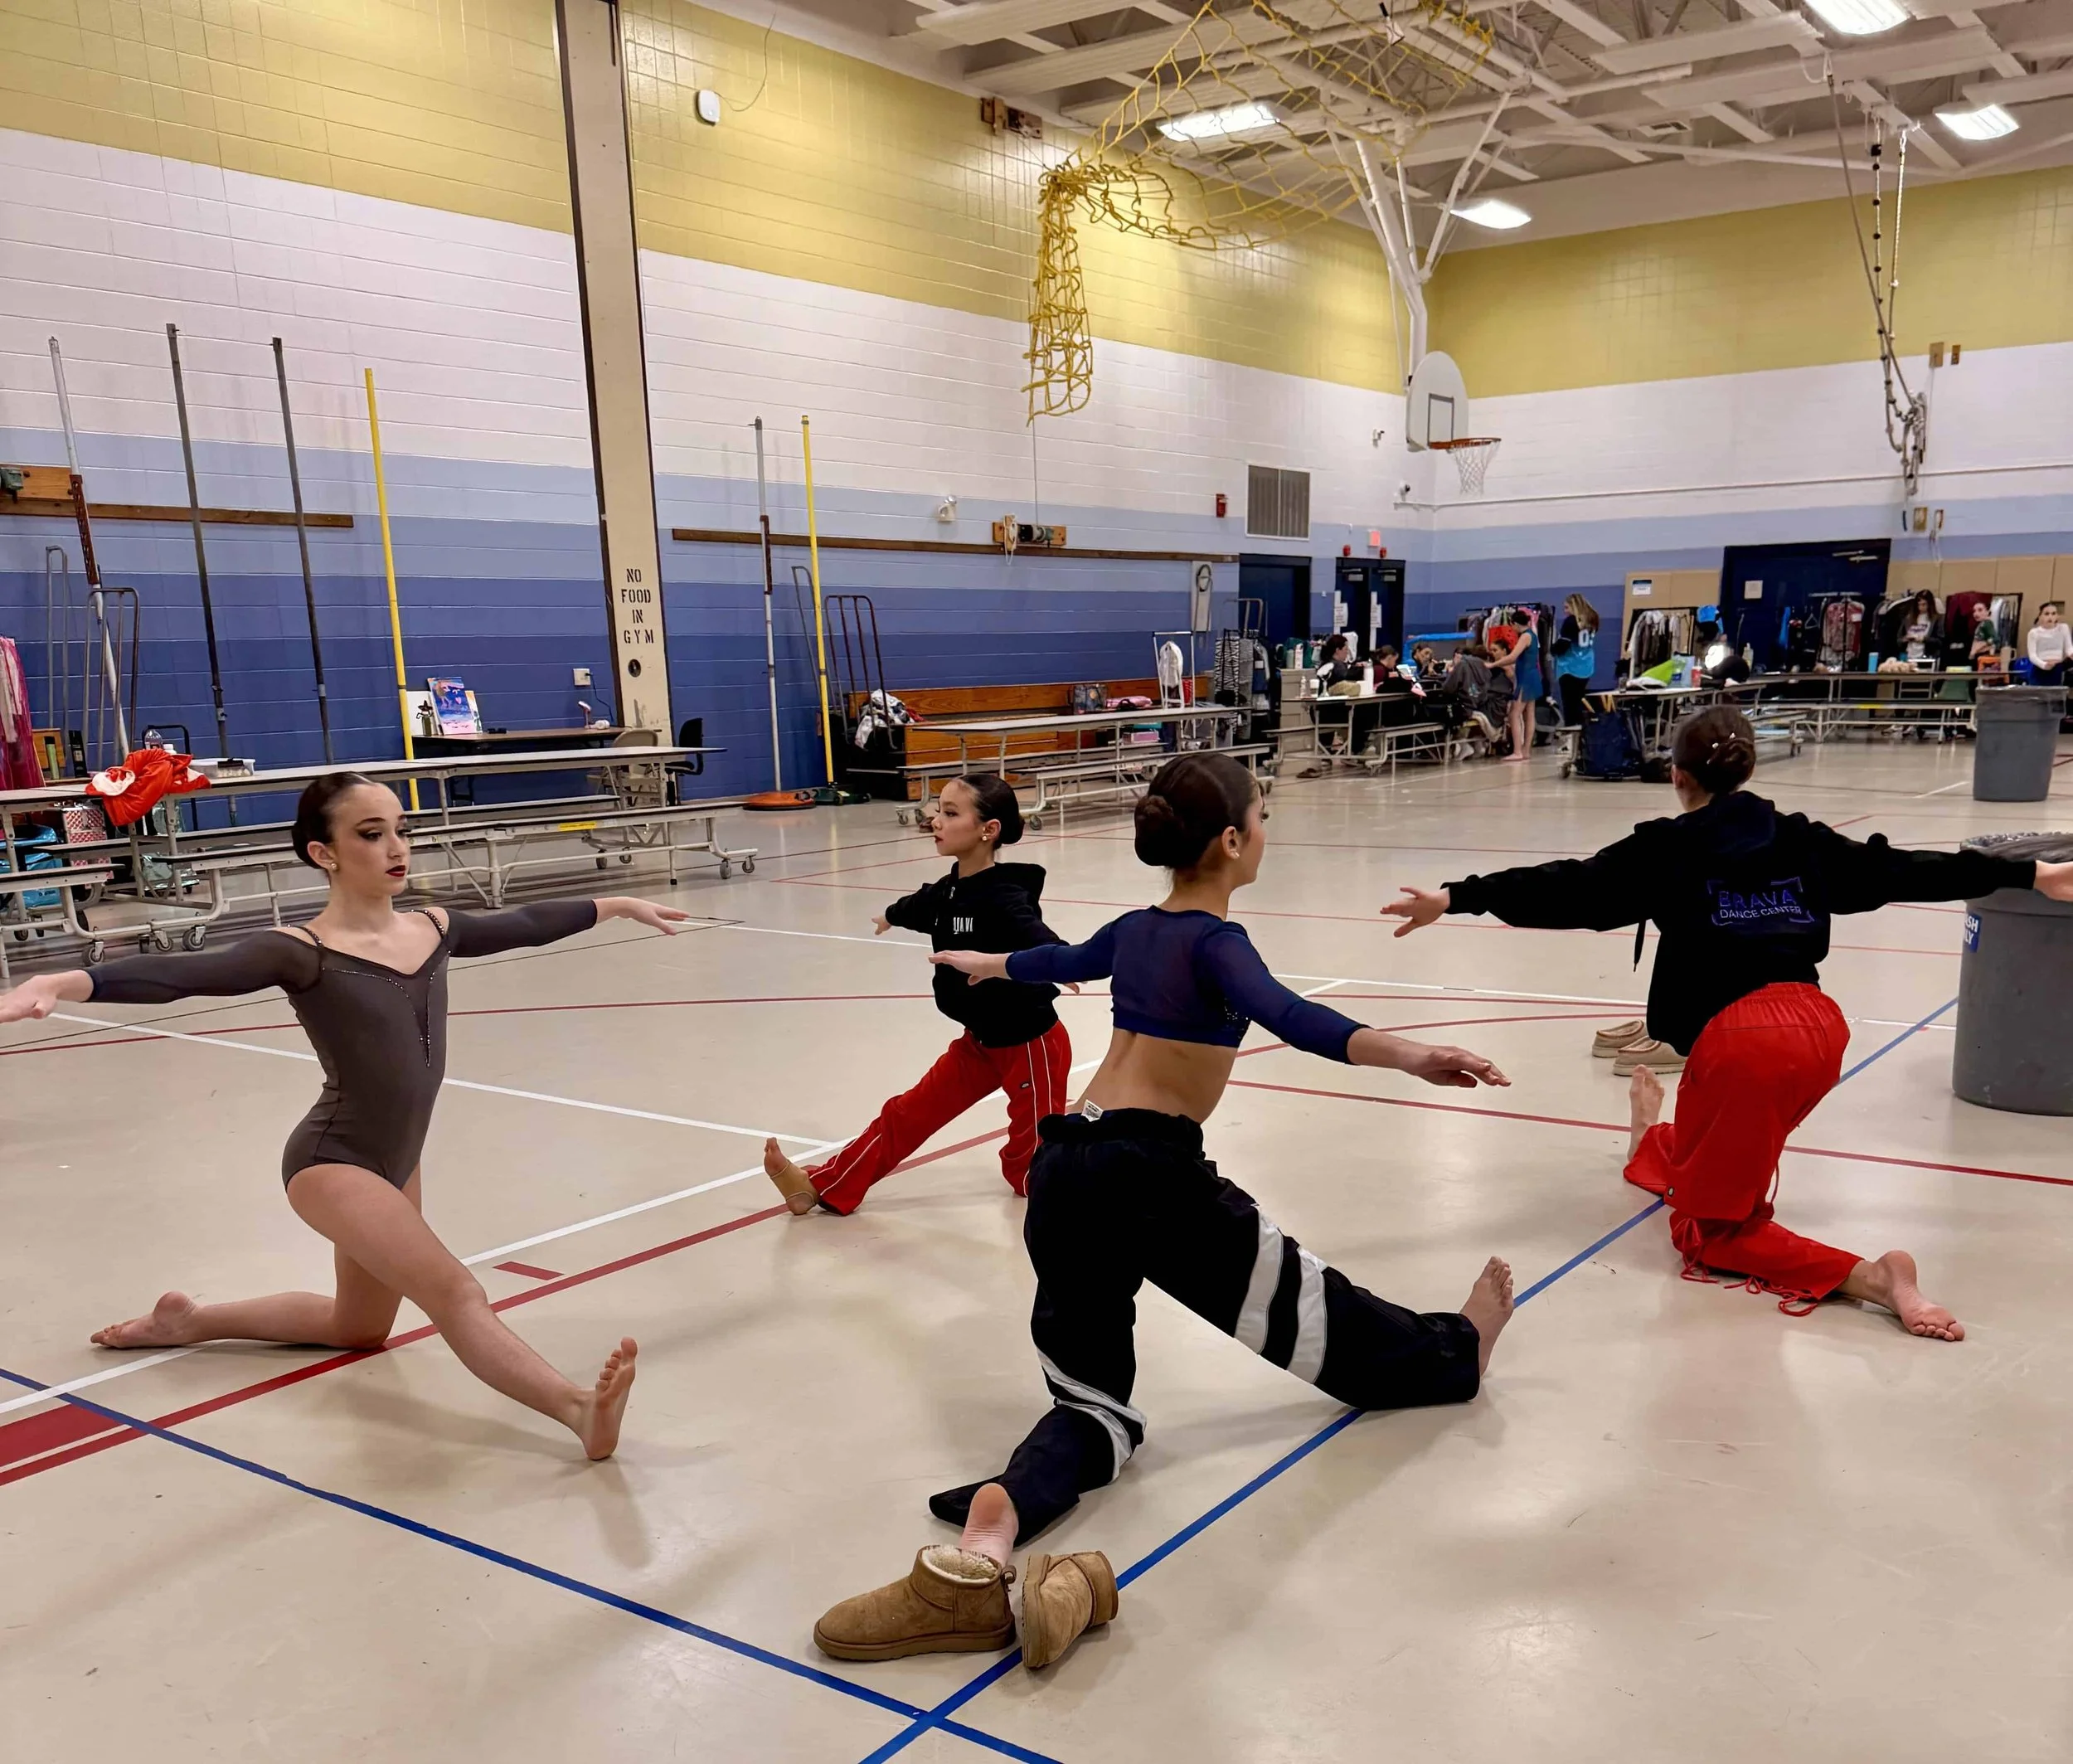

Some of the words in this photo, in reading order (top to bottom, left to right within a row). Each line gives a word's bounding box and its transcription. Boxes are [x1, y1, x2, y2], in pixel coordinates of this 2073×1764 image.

[626, 568, 643, 583] NO
[621, 589, 651, 603] FOOD
[633, 610, 643, 624] IN
[624, 629, 654, 644] GYM
[1720, 908, 1760, 919] DANCE
[1760, 905, 1803, 916] CENTER
